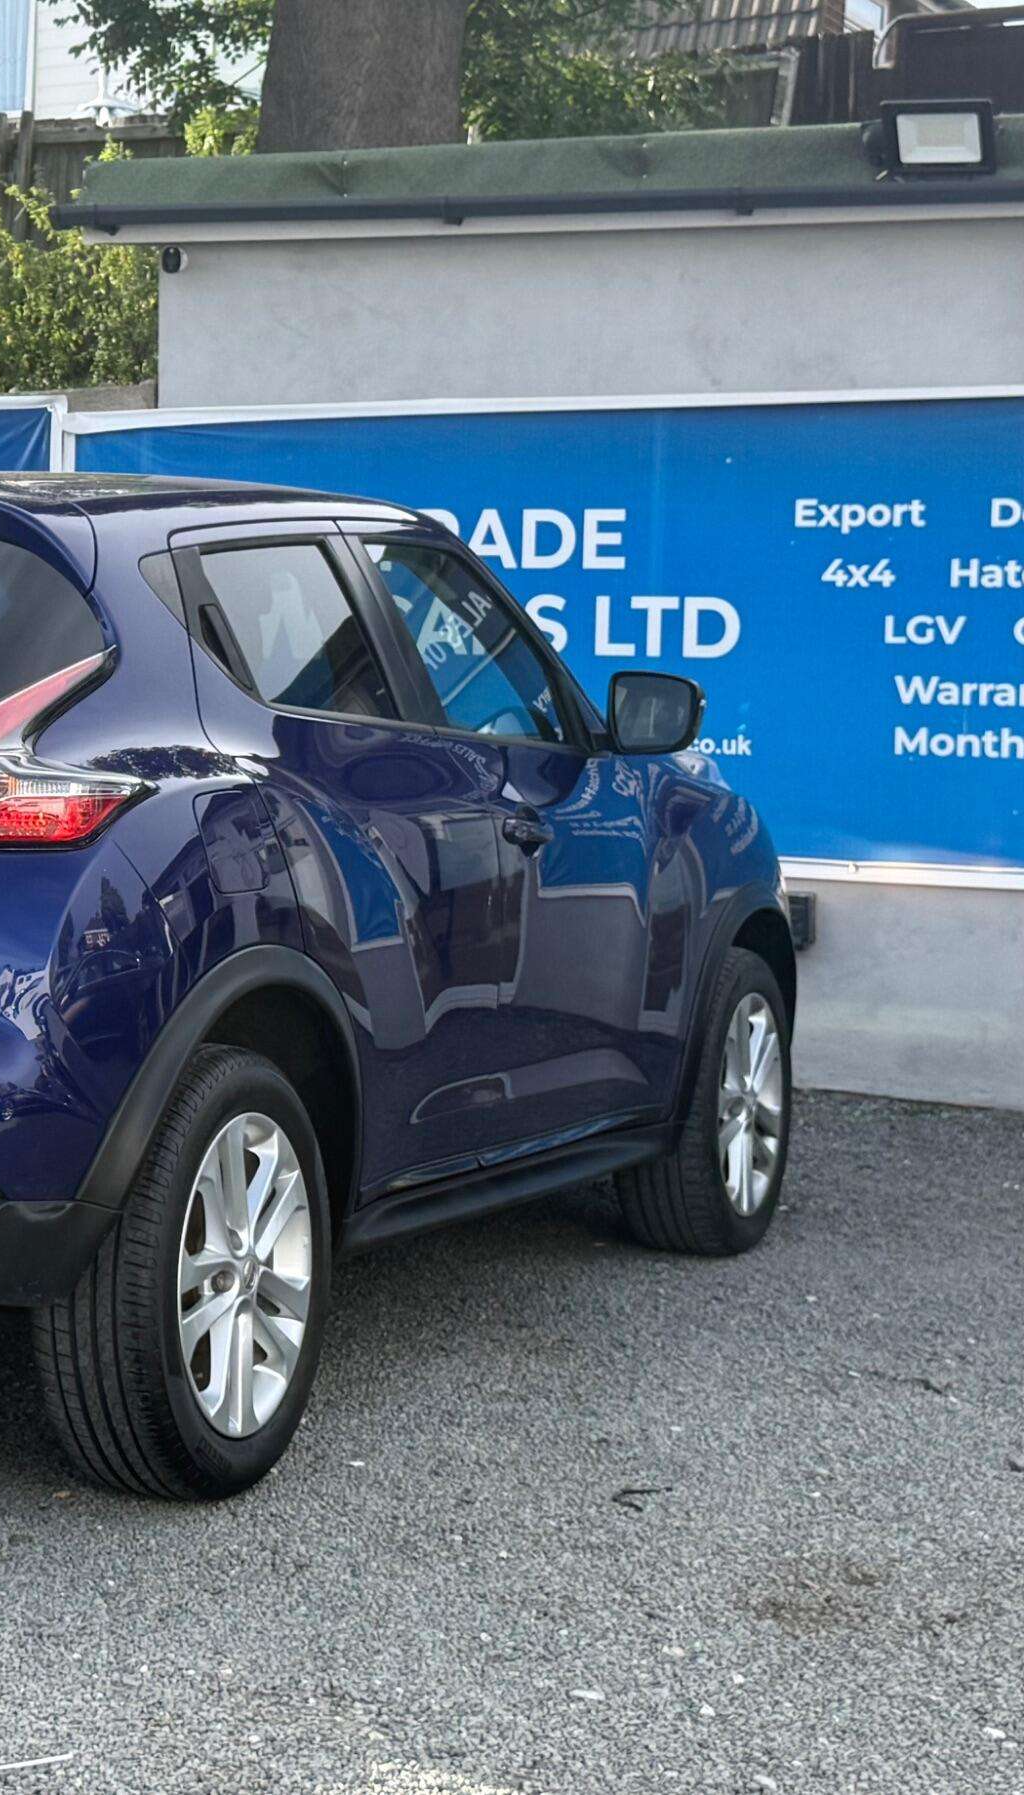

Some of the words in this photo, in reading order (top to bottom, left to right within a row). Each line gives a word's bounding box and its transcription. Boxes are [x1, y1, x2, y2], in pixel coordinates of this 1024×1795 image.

[794, 498, 927, 535] Export
[990, 498, 1024, 528] D
[821, 557, 897, 589] 4x4
[950, 558, 1024, 590] Hat
[594, 595, 742, 659] LTD
[884, 613, 968, 646] LGV
[894, 674, 1024, 708] Warra
[893, 726, 1024, 760] Month
